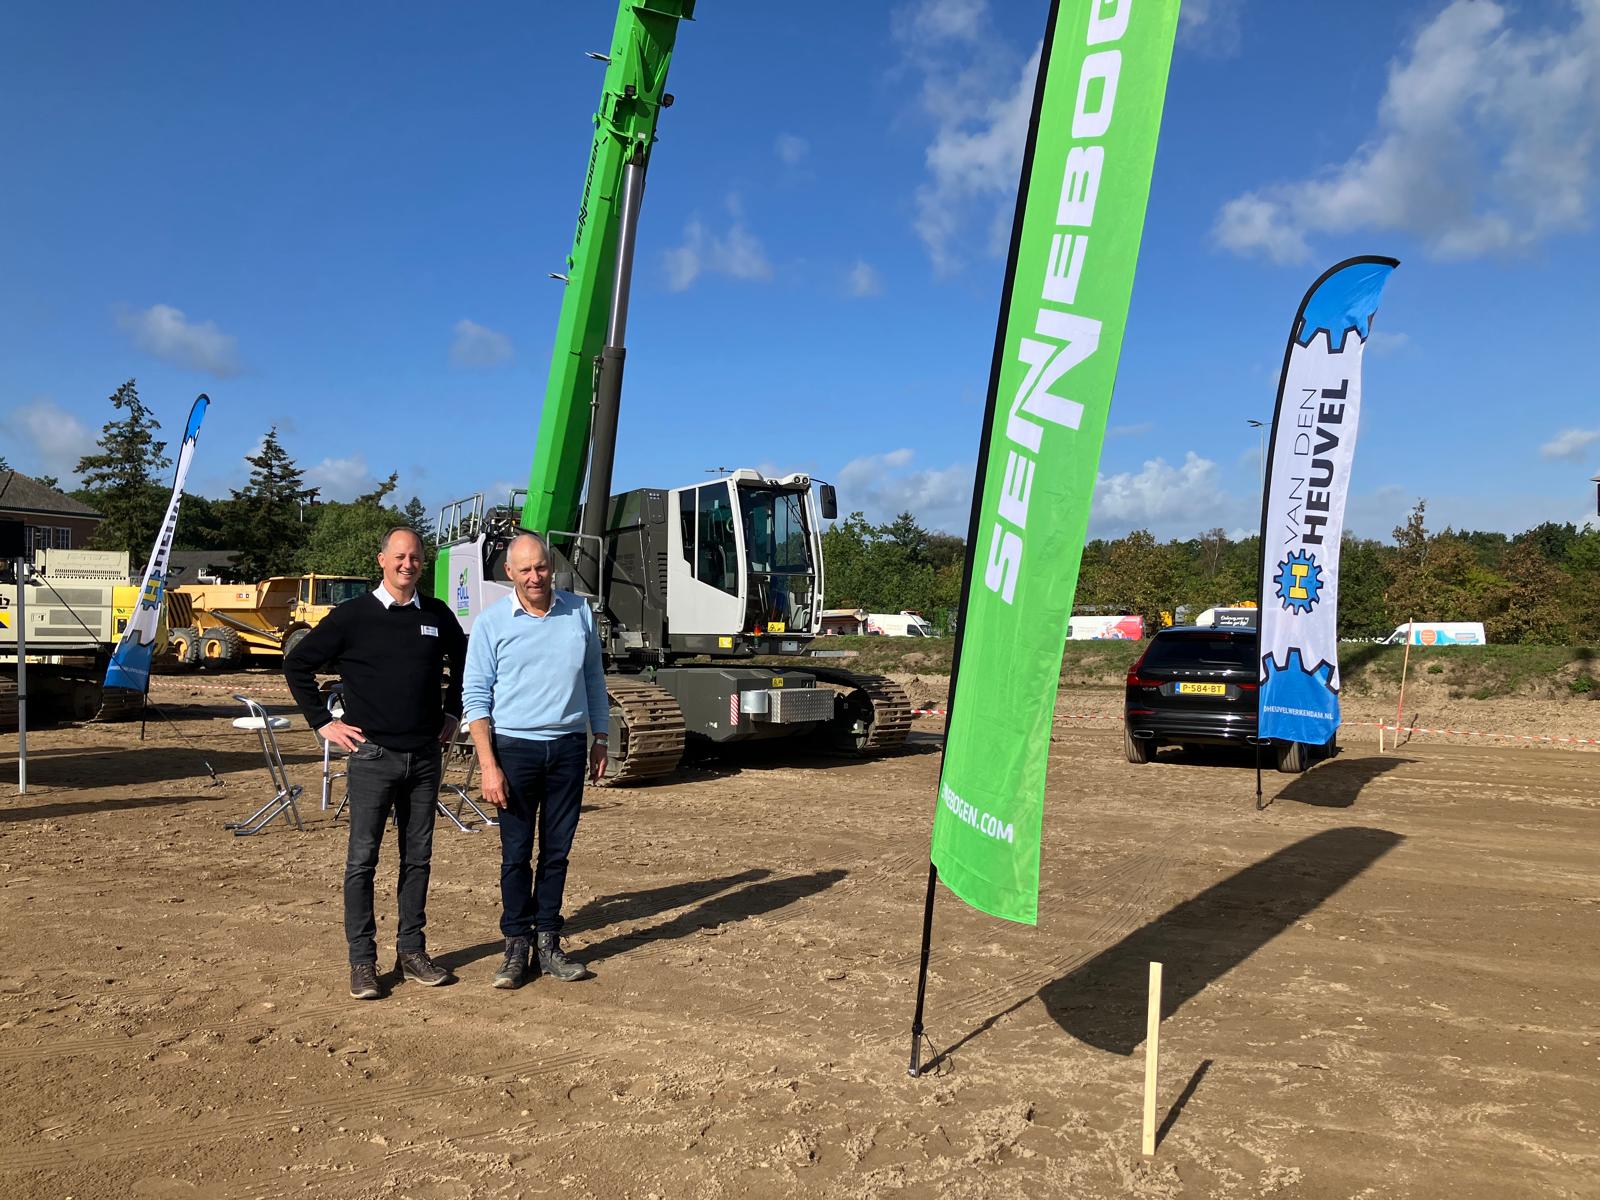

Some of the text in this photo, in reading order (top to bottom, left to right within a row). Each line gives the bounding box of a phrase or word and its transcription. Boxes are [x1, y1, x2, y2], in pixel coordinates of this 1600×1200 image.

[576, 138, 599, 247] SENNEBOGEN
[1284, 388, 1317, 545] VAN DEN
[1302, 379, 1349, 545] HEUVEL
[457, 586, 470, 600] FULL
[1182, 684, 1222, 693] P-584-BT
